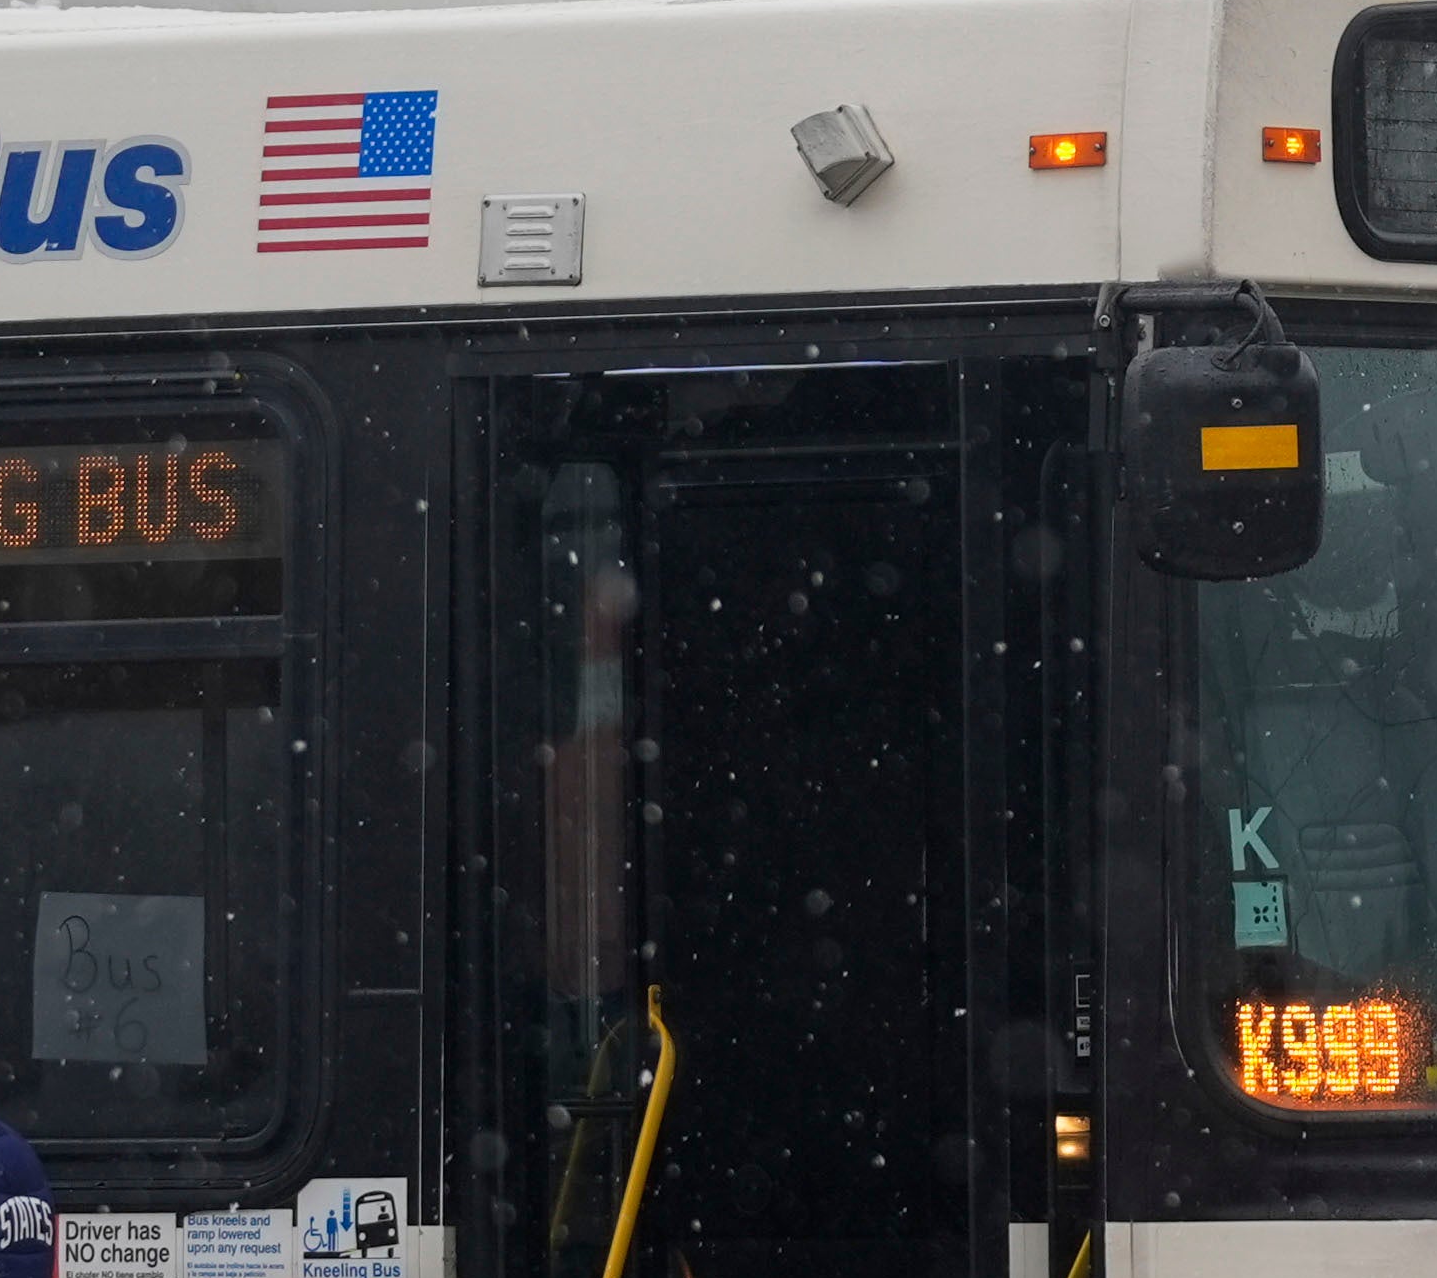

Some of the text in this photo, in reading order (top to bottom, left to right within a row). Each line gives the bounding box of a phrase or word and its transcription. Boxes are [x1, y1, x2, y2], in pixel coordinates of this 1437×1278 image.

[78, 451, 237, 546] BUS
[1228, 806, 1280, 872] K
[58, 915, 161, 993] Bus
[1238, 1004, 1400, 1092] K999
[0, 1195, 53, 1250] STATES
[65, 1220, 162, 1241] Driver has
[187, 1214, 271, 1226] Bus kneels and
[187, 1228, 261, 1242] ramp lowered
[65, 1243, 171, 1269] NO change
[187, 1243, 281, 1257] upon any request
[372, 1263, 401, 1278] Bus
